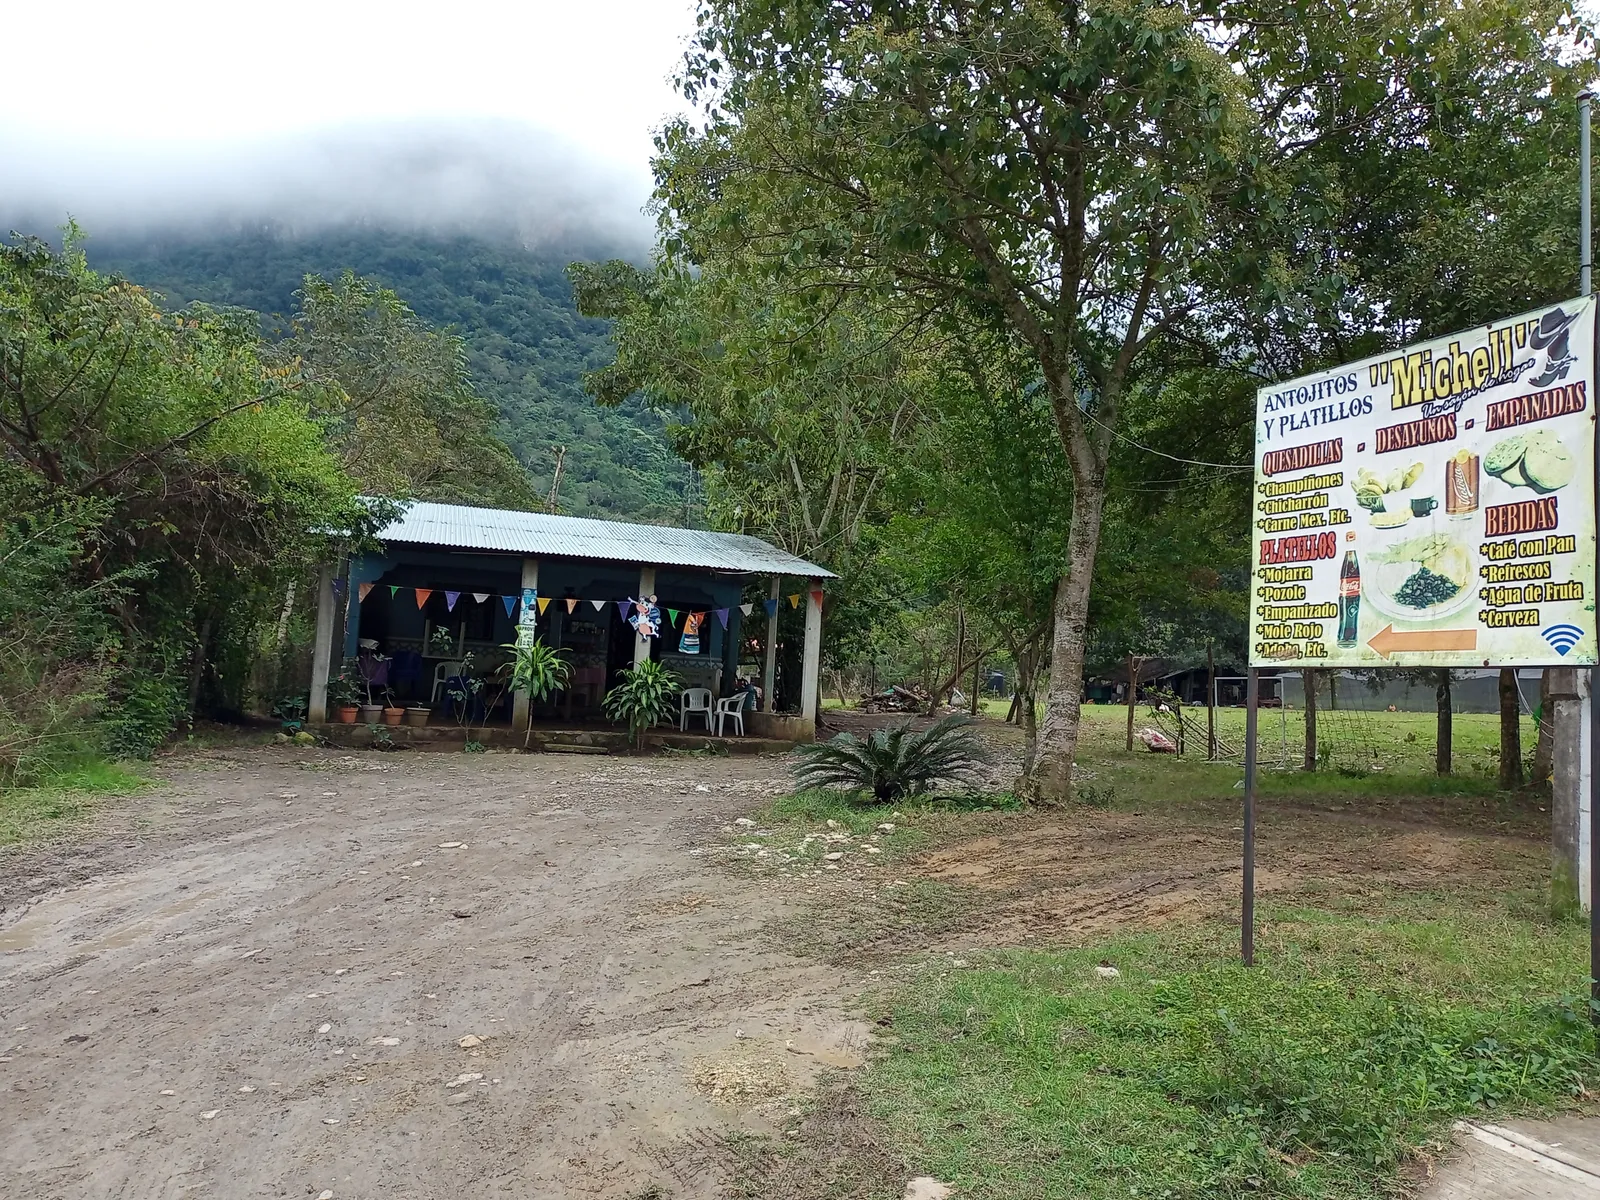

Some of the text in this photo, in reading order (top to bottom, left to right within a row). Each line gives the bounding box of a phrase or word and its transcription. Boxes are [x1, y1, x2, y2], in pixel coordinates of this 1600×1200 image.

[1263, 372, 1358, 413] ANTOJITOS
[1421, 358, 1536, 418] Un sazón de hogar
[1262, 437, 1343, 477] QUESADILLAS
[1375, 412, 1457, 454] DESAYUNOS
[1485, 380, 1586, 432] EMPANADAS
[1264, 395, 1373, 440] Y PLATILLOS
[1299, 512, 1327, 529] Mex.
[1328, 508, 1352, 525] Etc.
[1485, 496, 1558, 538] BEBIDAS
[1259, 531, 1337, 565] PLATILLOS
[1518, 539, 1544, 558] con
[1545, 535, 1576, 555] Pan
[1523, 584, 1543, 603] de
[1544, 580, 1584, 602] Fruta
[1292, 622, 1323, 640] Rojo
[1304, 641, 1328, 658] Etc.
